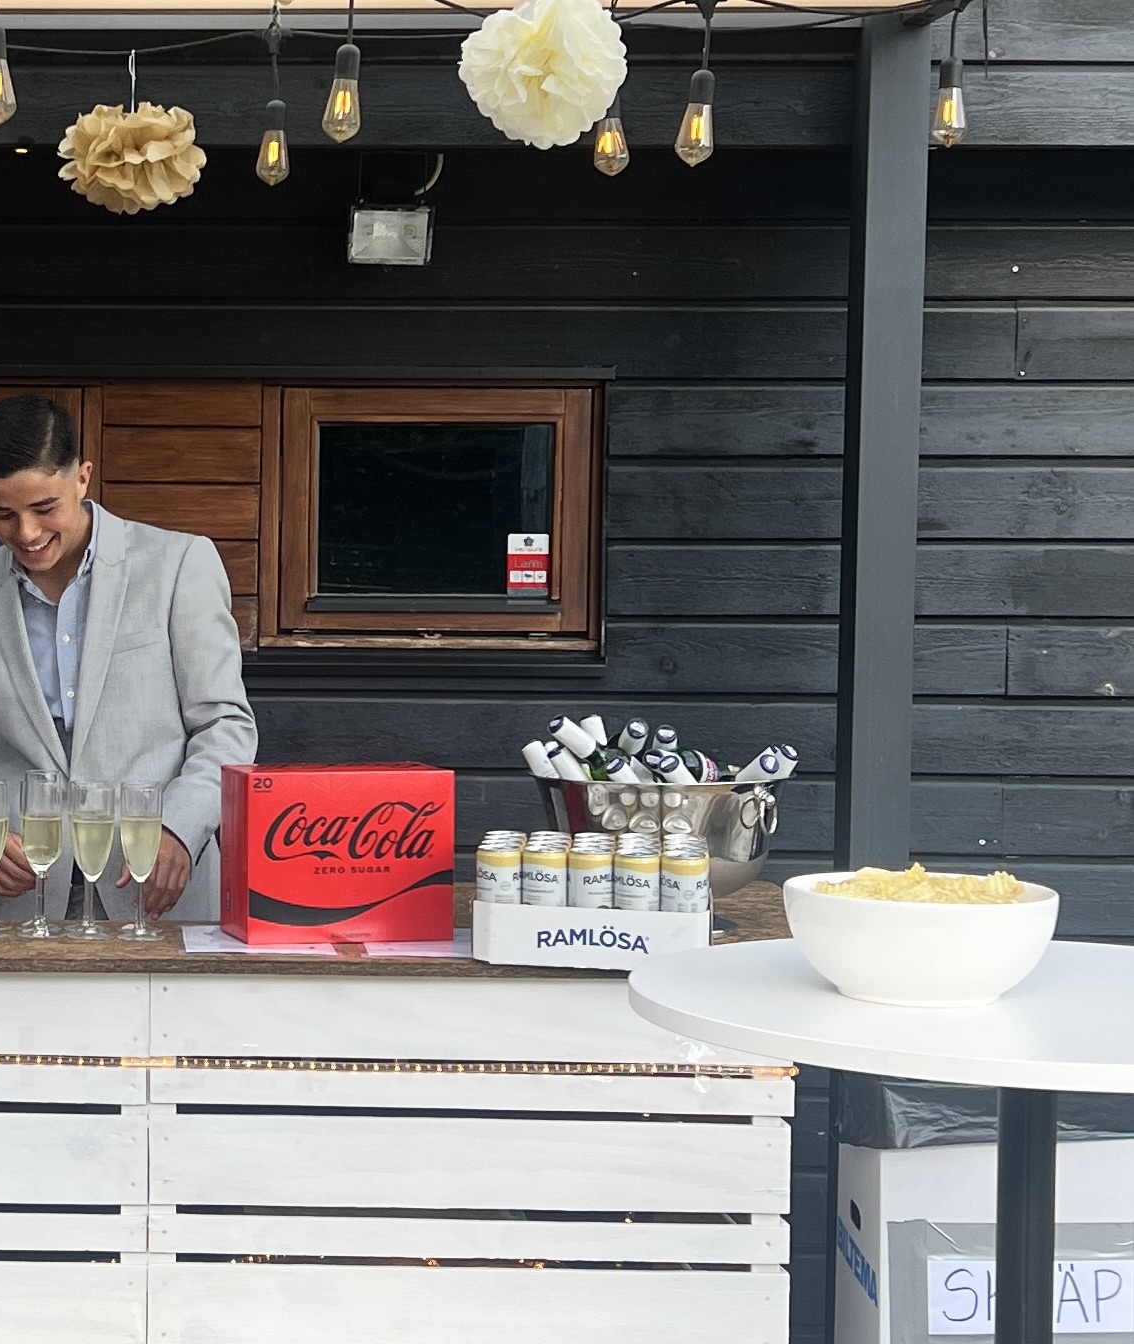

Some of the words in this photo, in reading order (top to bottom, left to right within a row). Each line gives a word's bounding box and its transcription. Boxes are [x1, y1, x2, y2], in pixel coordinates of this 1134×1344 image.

[252, 777, 273, 789] 20
[263, 801, 446, 861] Coca-Cola
[313, 866, 346, 875] ZERO
[350, 865, 391, 874] SUGAR
[537, 925, 649, 955] RAMLÖSA
[837, 1215, 879, 1309] BILTEMA
